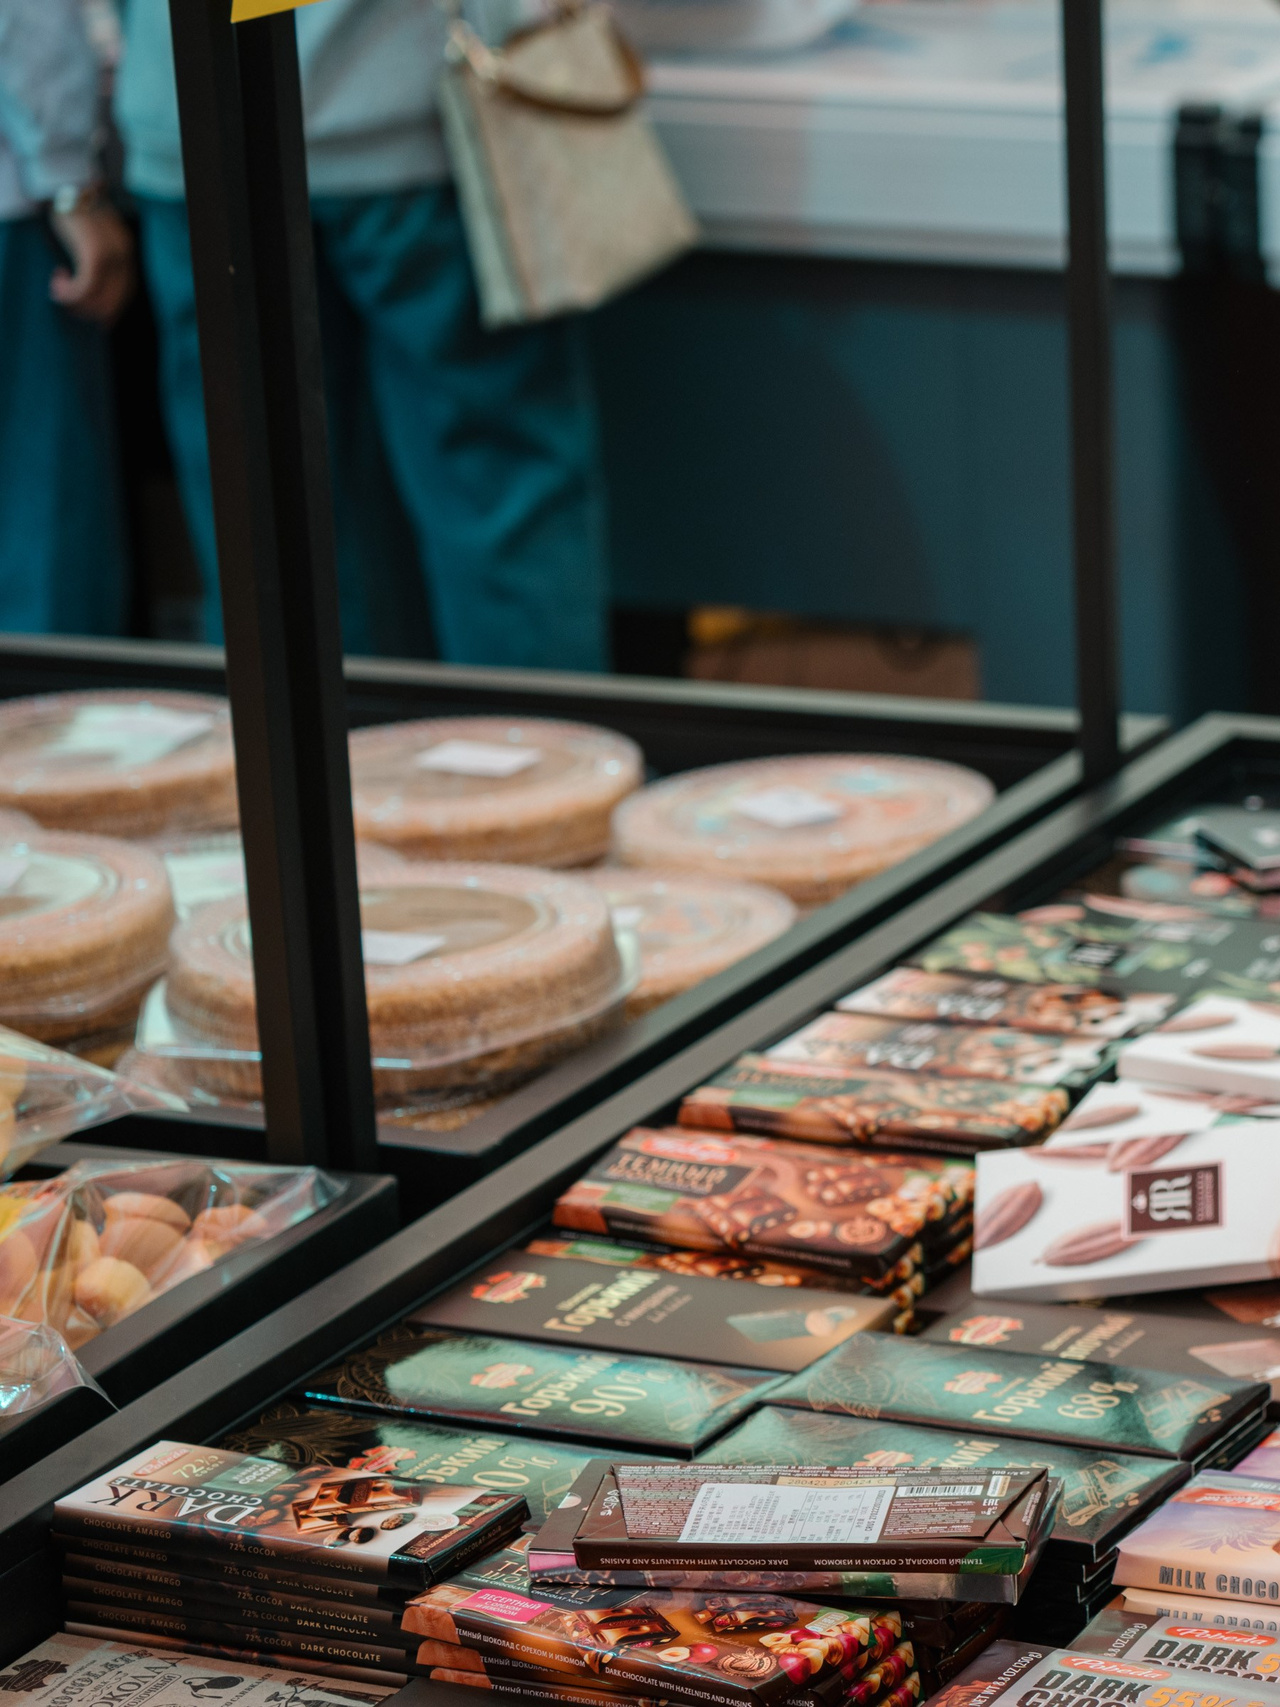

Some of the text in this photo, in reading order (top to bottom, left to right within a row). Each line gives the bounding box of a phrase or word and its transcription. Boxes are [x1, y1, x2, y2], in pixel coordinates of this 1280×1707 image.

[500, 1355, 618, 1416] Горький
[570, 1370, 673, 1417] 90%
[972, 1362, 1085, 1423] Горький
[1058, 1380, 1138, 1420] 68%
[173, 1455, 218, 1479] 72%
[237, 1463, 278, 1485] COCOA
[473, 1456, 558, 1487] 0%
[109, 1477, 262, 1506] CHOCOLATE
[88, 1485, 259, 1526] DARK
[83, 1517, 172, 1539] CHOCOLATE AMARGO
[82, 1540, 168, 1562] CHOCOLATE AMARGO
[229, 1543, 277, 1557] 72% COCOA
[719, 1558, 766, 1566] CHOCOLATE
[905, 1558, 947, 1566] ШОКОЛАД
[949, 1558, 983, 1566] ТЕМНЫЙ
[95, 1563, 181, 1587] CHOCOLATE AMARGO
[224, 1566, 240, 1575] 72%
[242, 1569, 269, 1581] COCOA
[1159, 1566, 1206, 1590] MILK
[93, 1586, 183, 1607] CHOCOLATE AMARGO
[491, 1579, 528, 1592] CHOCOLATE
[531, 1589, 566, 1602] CHOCOLAT
[237, 1591, 253, 1601] 72%
[255, 1594, 283, 1606] COCOA
[478, 1592, 542, 1611] ДЕСЕРТНЫЙ
[491, 1602, 522, 1612] ОРЕХОМ
[97, 1611, 187, 1631] CHOCOLATE AMARGO
[242, 1609, 259, 1618] 72%
[261, 1612, 289, 1623] COCOA
[456, 1627, 482, 1641] ТЕМНЫЙ
[482, 1634, 515, 1651] ШОКОЛАД
[521, 1645, 548, 1658] ОРЕХОМ
[554, 1653, 586, 1668] ИЗЮМОМ
[1113, 1636, 1126, 1649] OZ
[1173, 1627, 1268, 1646] Pobeda
[245, 1634, 381, 1662] 72% COCOA DARK CHOCOLATE
[1144, 1639, 1260, 1671] DARK
[480, 1655, 510, 1667] ТЕМНЫЙ
[1070, 1656, 1163, 1679] Pobeda
[89, 1656, 190, 1707] ОКОЛАД
[605, 1667, 752, 1707] DARK CHOCOLATE WITH HAZELNUTS AND RAISINS
[969, 1694, 989, 1707] NET
[985, 1682, 1000, 1697] WT
[1004, 1665, 1019, 1677] OZ
[1013, 1653, 1034, 1670] (250
[1033, 1669, 1152, 1704] DARK
[567, 1695, 598, 1706] ОРЕХОМ
